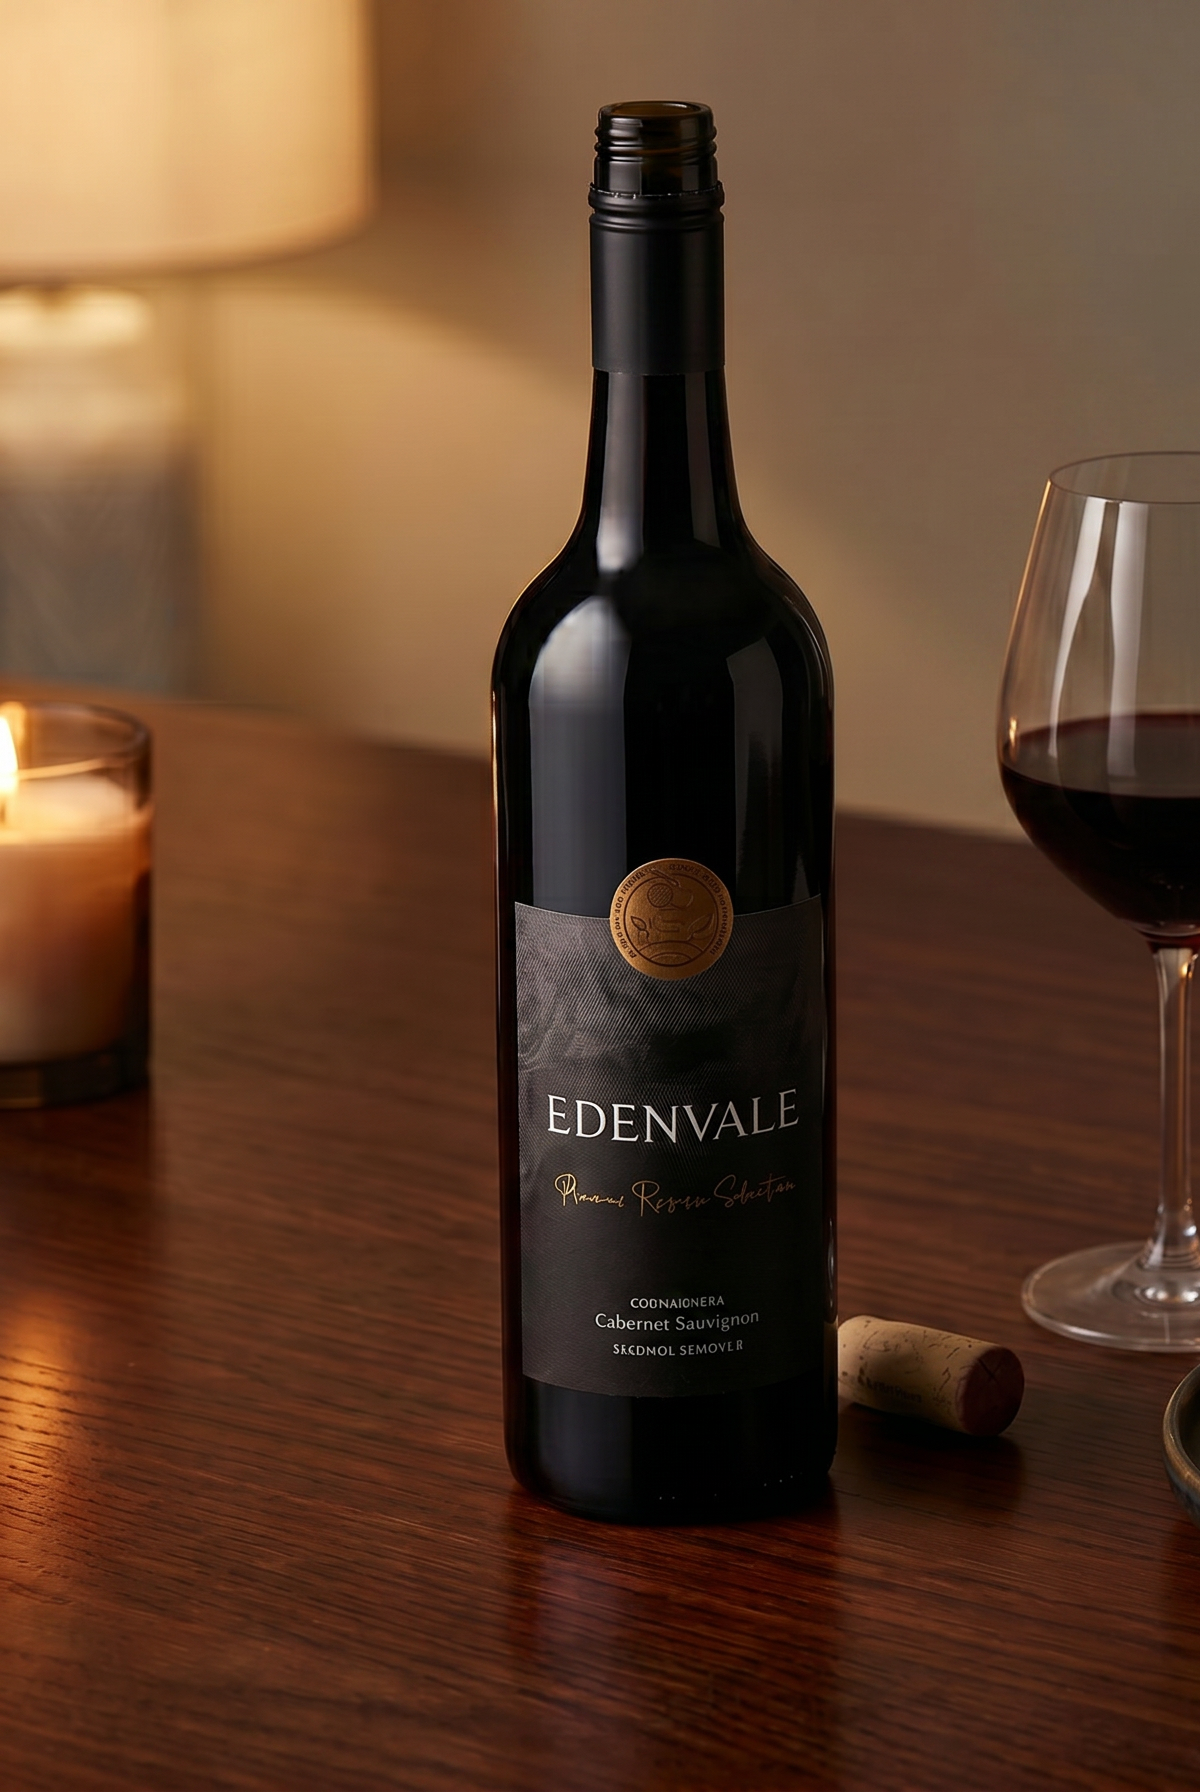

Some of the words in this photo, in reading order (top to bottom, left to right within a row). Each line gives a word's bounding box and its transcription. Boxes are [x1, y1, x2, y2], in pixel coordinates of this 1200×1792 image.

[548, 1088, 800, 1144] EDENVALE
[594, 1313, 670, 1332] Cabernet
[675, 1311, 760, 1332] Sauvignon
